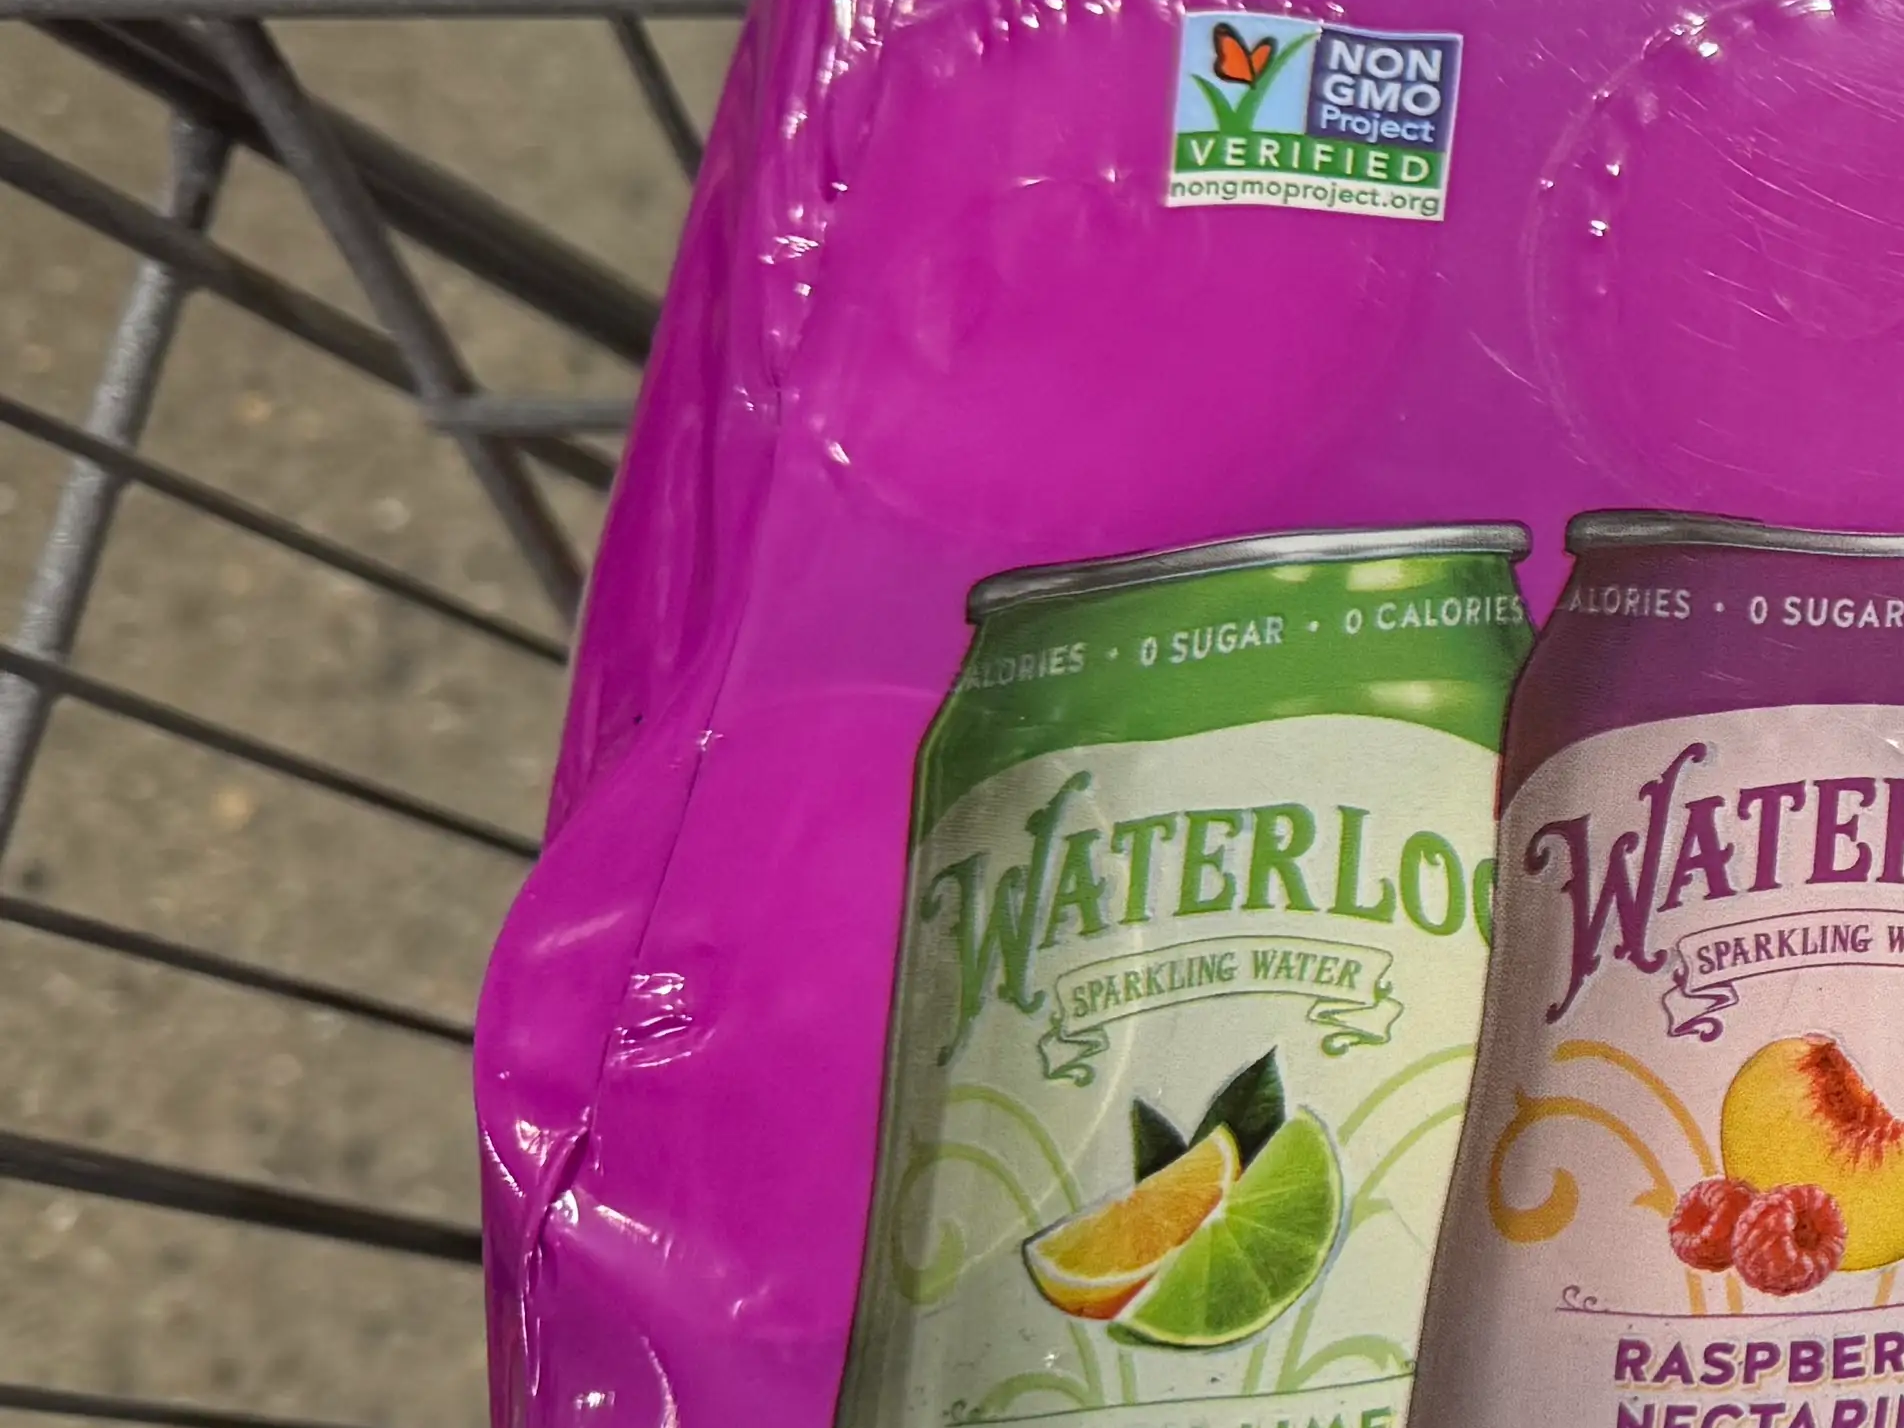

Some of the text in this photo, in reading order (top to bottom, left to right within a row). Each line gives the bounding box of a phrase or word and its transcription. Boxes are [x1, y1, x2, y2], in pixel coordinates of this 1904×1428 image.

[1327, 40, 1443, 83] NON
[1319, 78, 1443, 117] GMO
[1320, 106, 1435, 146] Project
[1191, 139, 1431, 184] VERIFIED
[1170, 179, 1441, 218] nongmoproject.org
[1566, 587, 1692, 620] ALORIES
[958, 641, 1088, 692] ALORIES
[1170, 616, 1285, 666] SUGAR
[1376, 594, 1525, 633] CALORIES
[1698, 923, 1875, 975] SPARKLING
[1072, 949, 1364, 1019] SPARKLING WATER
